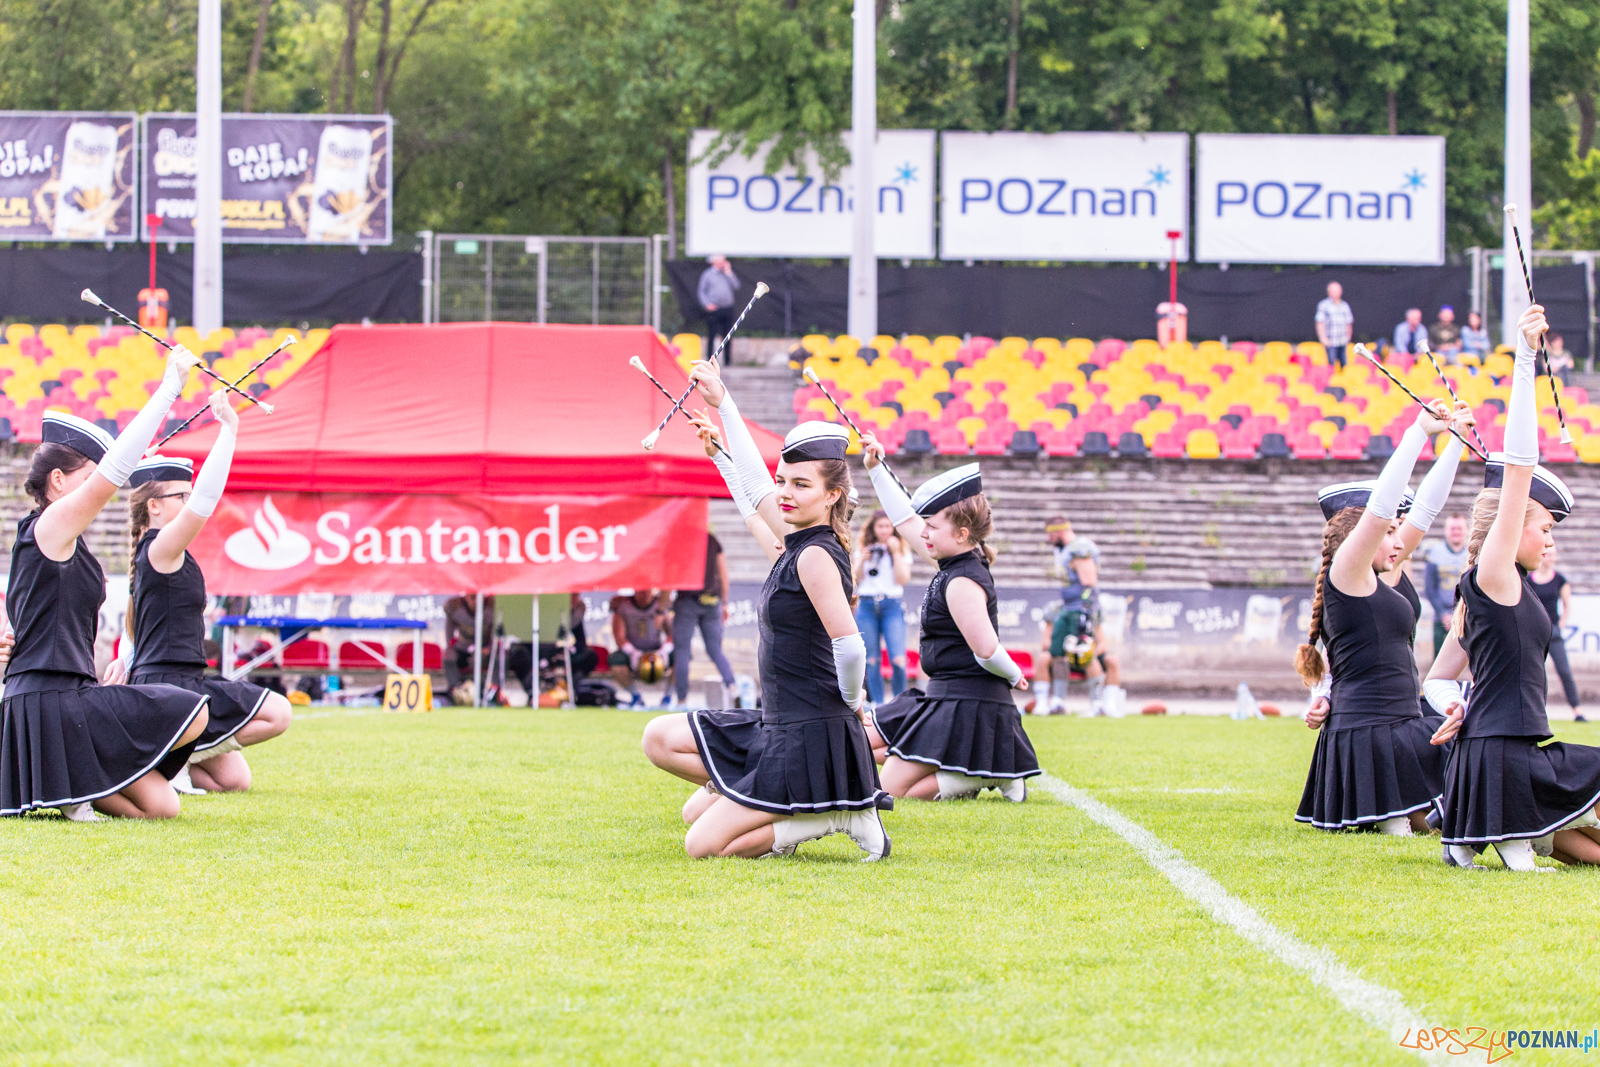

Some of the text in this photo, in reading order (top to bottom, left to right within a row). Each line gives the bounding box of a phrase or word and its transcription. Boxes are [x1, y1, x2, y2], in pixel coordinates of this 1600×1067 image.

[227, 142, 283, 167] DAJE
[239, 148, 309, 182] KOPA!
[314, 504, 627, 565] Santander
[388, 680, 420, 710] 30
